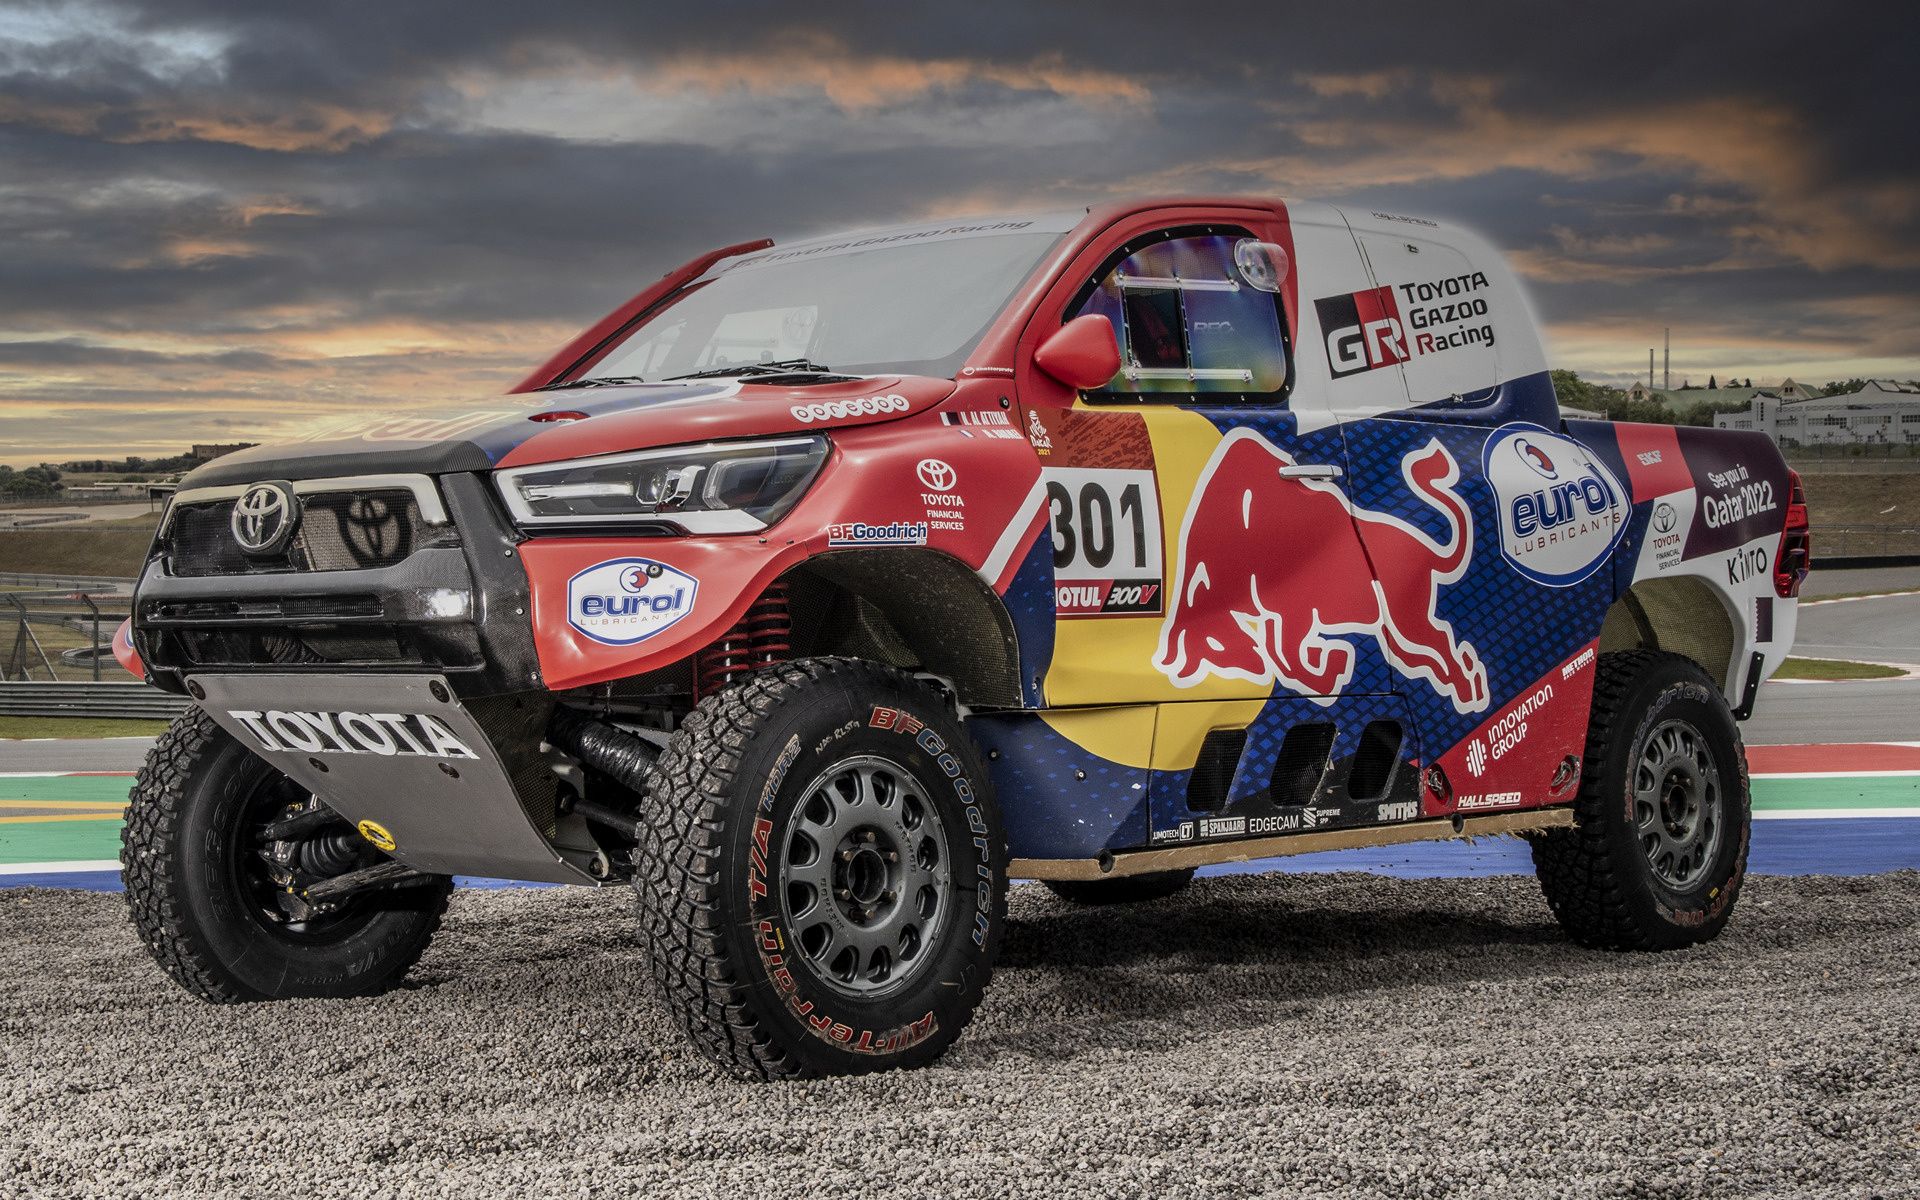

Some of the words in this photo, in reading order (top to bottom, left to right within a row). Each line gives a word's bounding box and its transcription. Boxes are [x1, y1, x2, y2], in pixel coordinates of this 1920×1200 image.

[851, 229, 942, 248] GAZOO
[941, 220, 1035, 236] Racing
[1399, 271, 1490, 304] TOYOTA
[1409, 298, 1488, 329] GAZOO
[1327, 317, 1408, 373] GR
[1415, 324, 1495, 355] Racing
[790, 395, 910, 423] ooredoo
[1037, 448, 1051, 456] 2021
[1636, 450, 1663, 466] SKF
[1708, 472, 1727, 489] See
[1725, 468, 1742, 489] you
[1737, 463, 1749, 479] in
[921, 493, 965, 507] TOYOTA
[1511, 462, 1618, 539] eurol
[1703, 494, 1743, 529] Qatar
[1742, 480, 1777, 516] 2022
[927, 509, 964, 520] FINANCIAL
[931, 520, 964, 531] SERVICES
[1046, 481, 1146, 569] 301
[828, 521, 927, 541] BFGoodrich
[1514, 512, 1621, 556] LUBRICANTS
[1653, 533, 1681, 549] TOYOTA
[1656, 550, 1680, 561] FINANCIAL
[1659, 558, 1681, 571] SERVICES
[580, 587, 686, 618] eurol
[1107, 584, 1158, 605] 300V
[580, 611, 681, 627] LUBRICANTS
[227, 710, 481, 760] TOYOTA
[1491, 722, 1528, 760] GROUP
[1316, 808, 1341, 817] SUPREME
[1378, 800, 1418, 822] SMITHS
[1457, 792, 1522, 809] HALLSPEED
[750, 818, 773, 902] T/A
[762, 739, 801, 812] KDR2
[869, 706, 991, 946] BFGoodrich
[1209, 818, 1245, 834] SPANJAARD
[1250, 814, 1299, 833] EDGECAM
